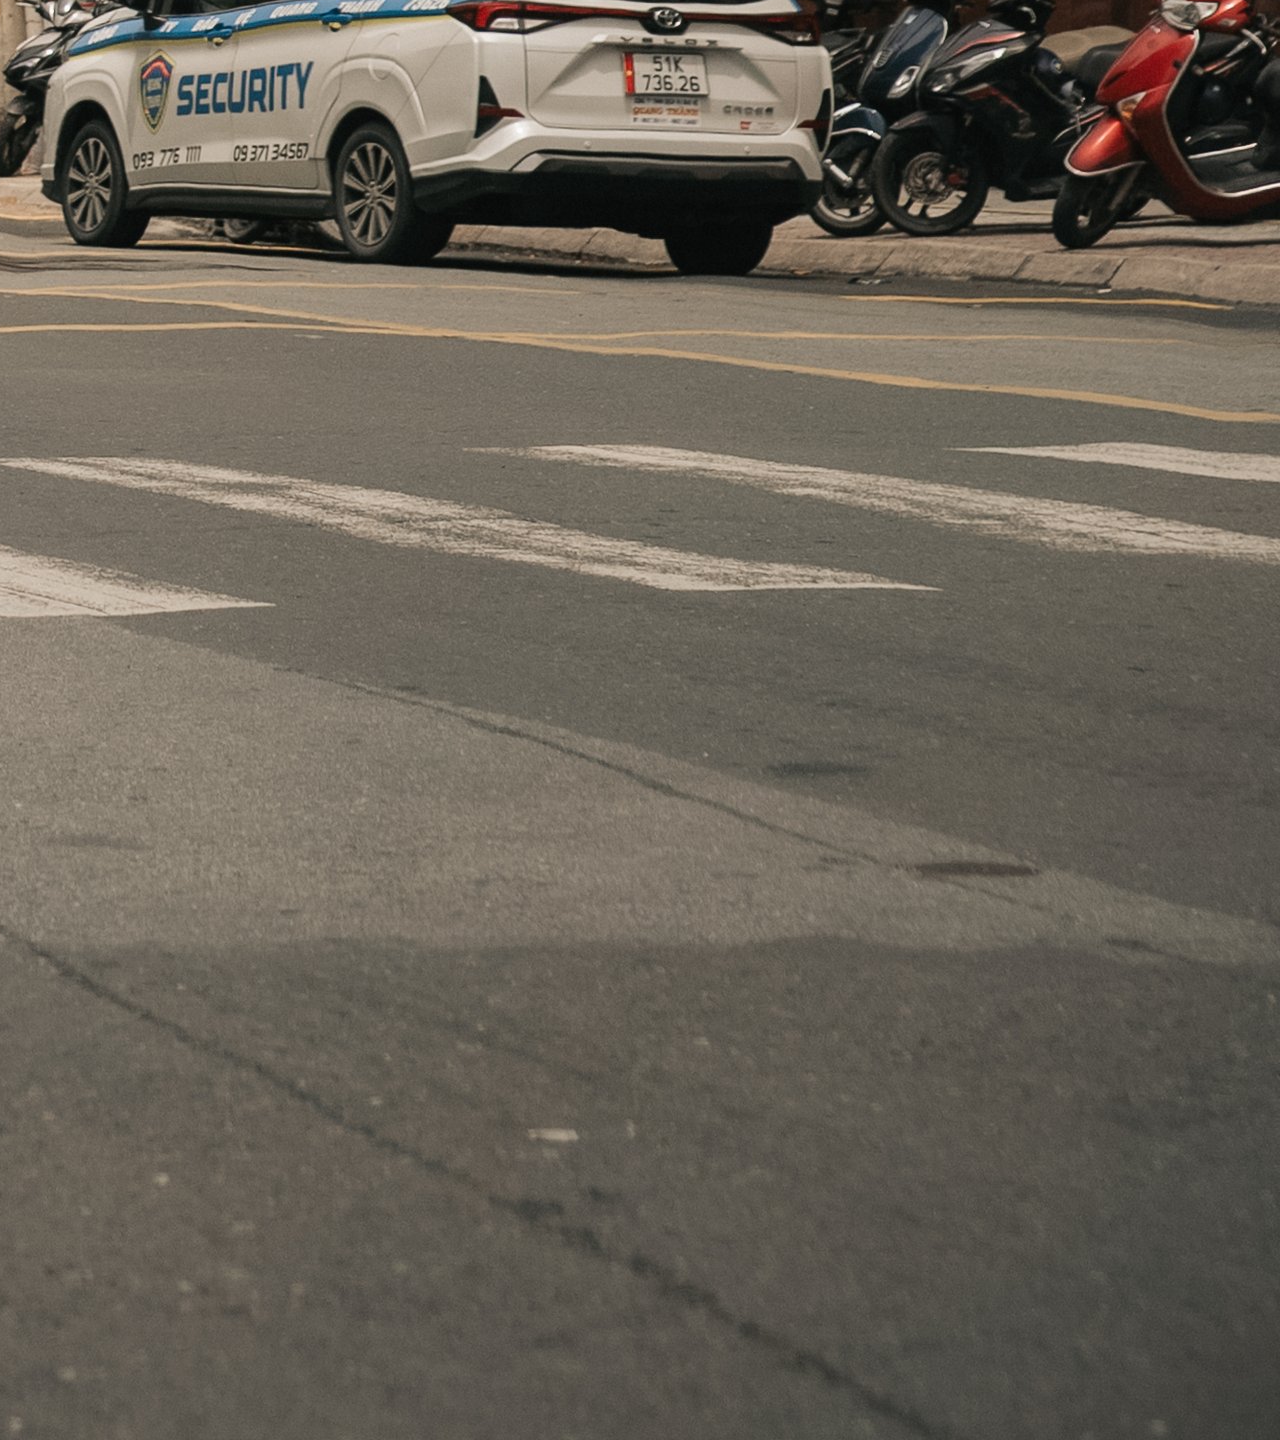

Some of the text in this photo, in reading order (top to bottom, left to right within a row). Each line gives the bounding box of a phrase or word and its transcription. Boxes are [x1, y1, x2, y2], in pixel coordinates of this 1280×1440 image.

[653, 56, 684, 73] 51K
[176, 62, 314, 116] SECURITY
[642, 74, 700, 92] 736.26
[133, 151, 155, 170] 093
[160, 148, 180, 165] 776
